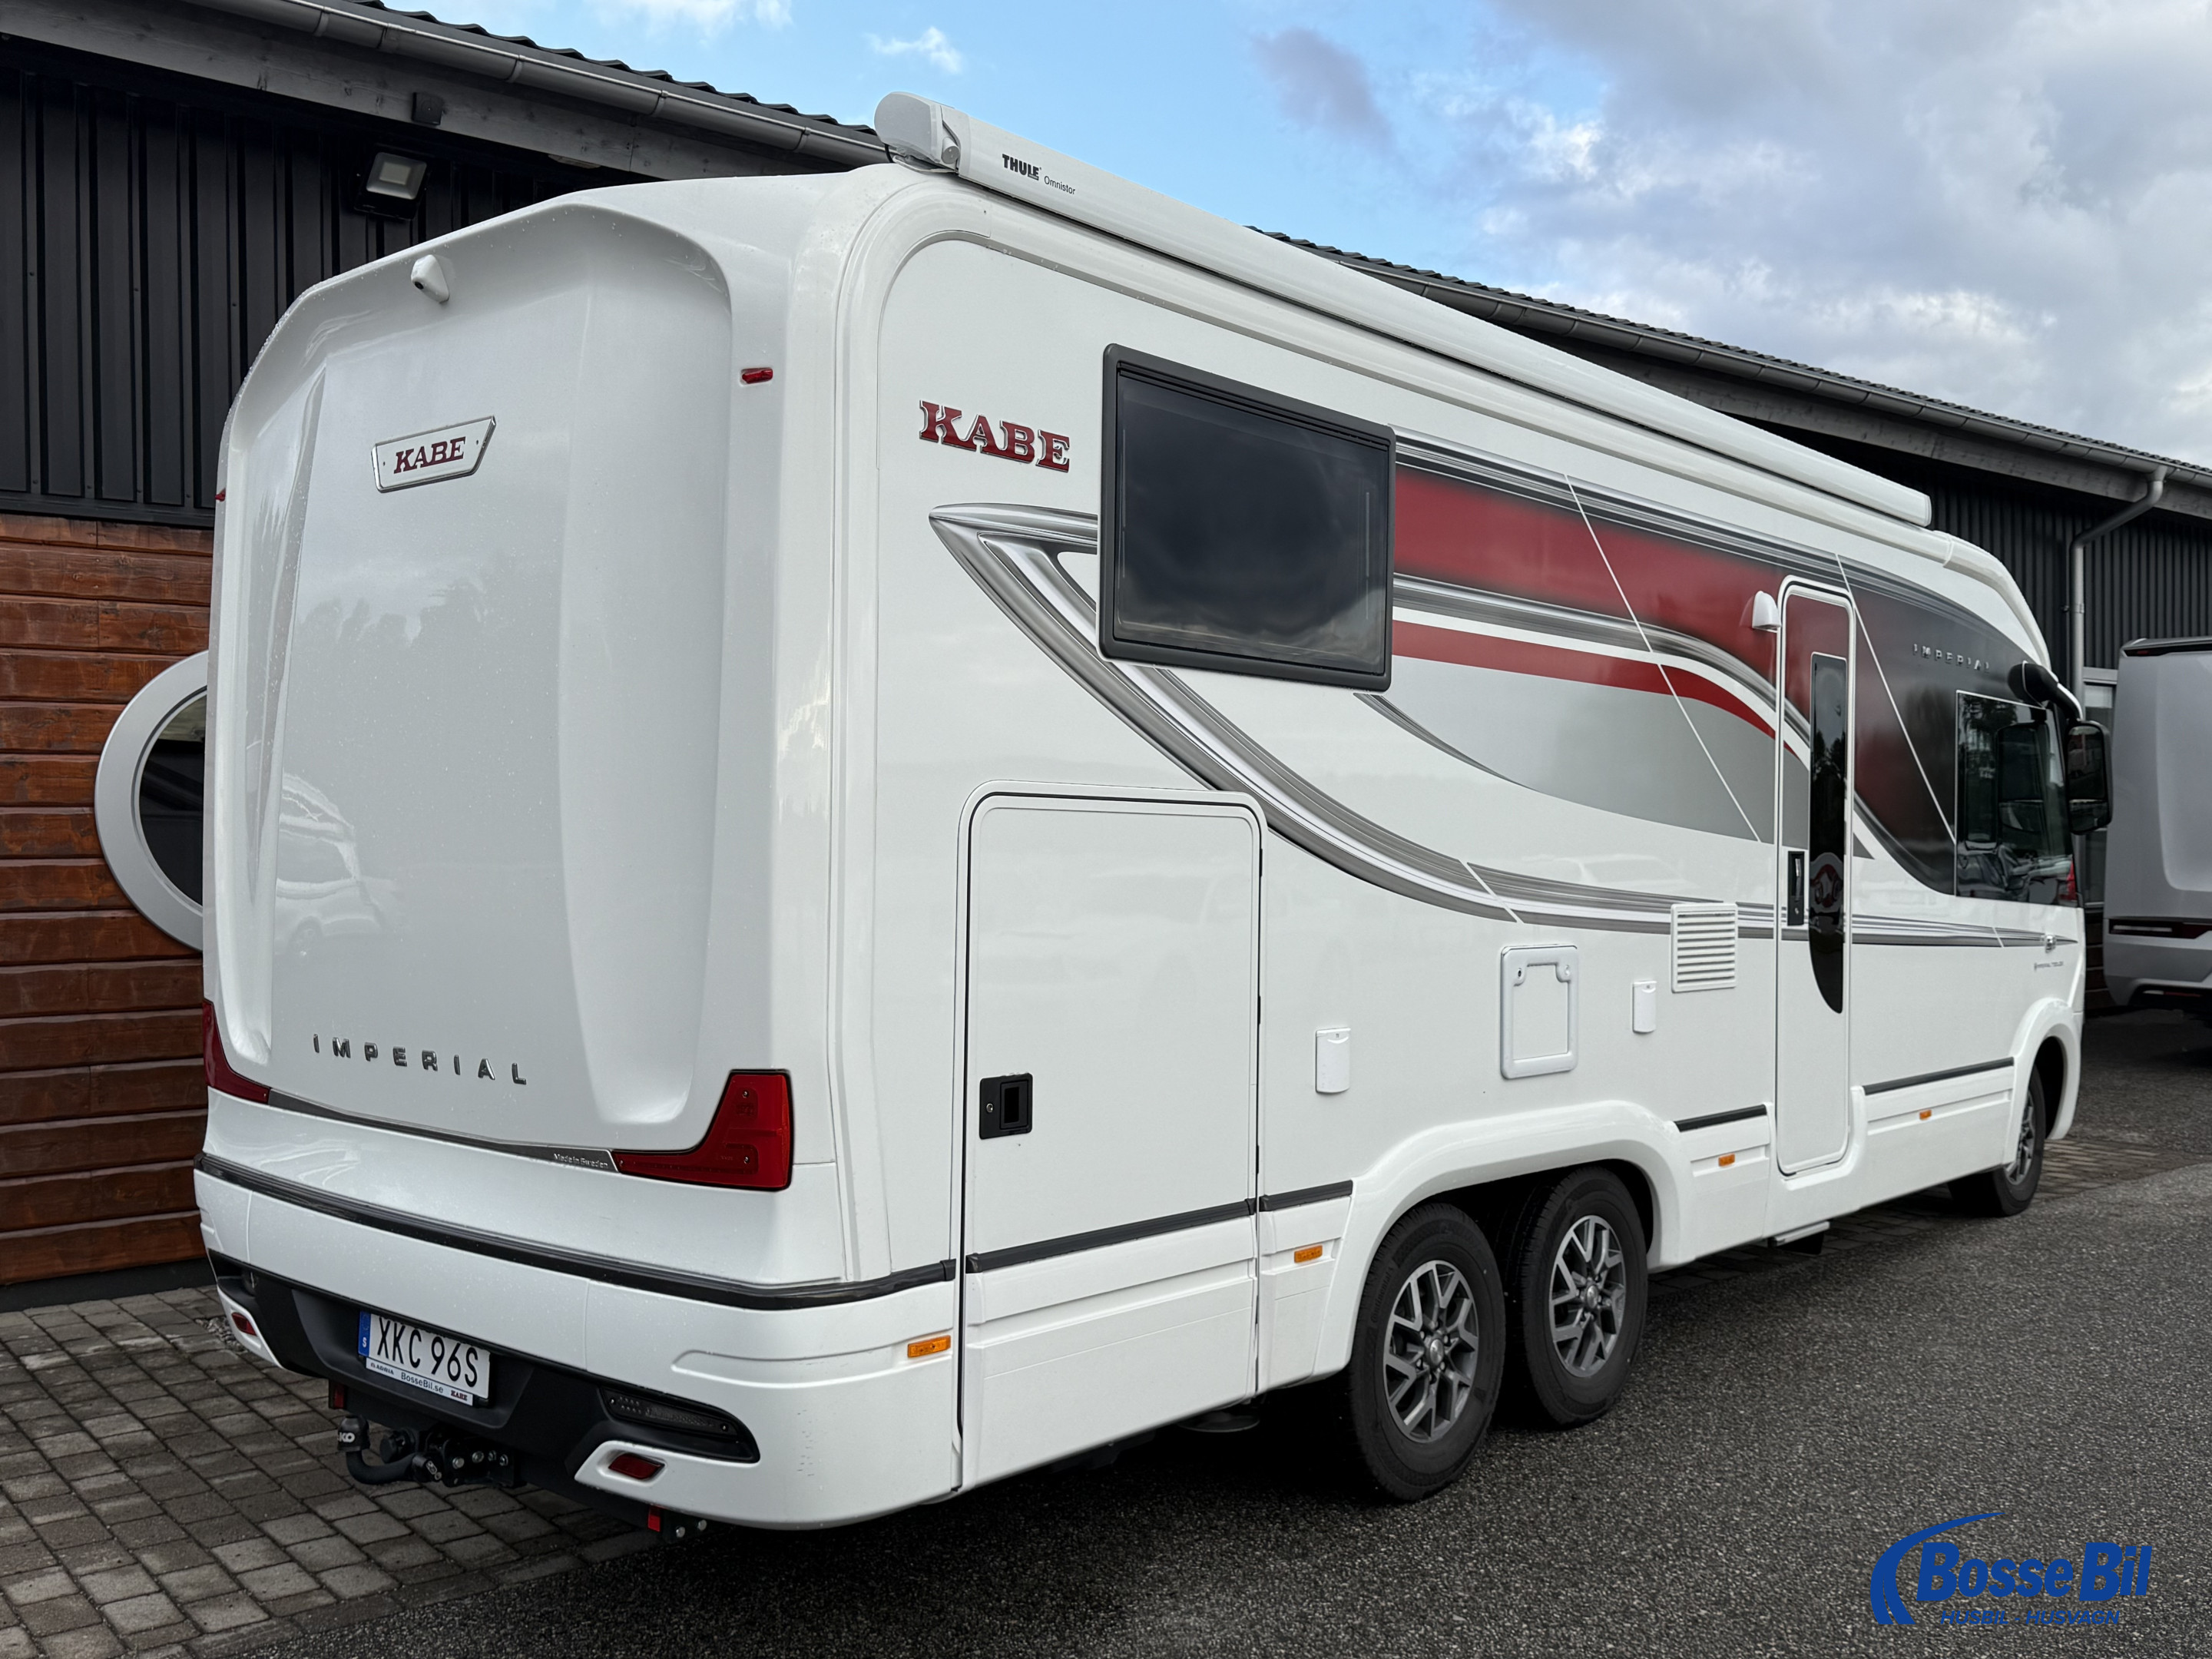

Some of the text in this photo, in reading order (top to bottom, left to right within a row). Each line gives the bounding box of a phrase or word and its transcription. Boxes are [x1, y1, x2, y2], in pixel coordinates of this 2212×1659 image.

[1002, 154, 1076, 194] THULE Omnistor
[393, 436, 466, 474] KABE
[919, 399, 1071, 473] KABE
[313, 1034, 527, 1085] IMPERIAL
[580, 1157, 609, 1168] Sweden
[376, 1316, 478, 1388] XKC 96S
[376, 1365, 395, 1375] ADRIA
[400, 1372, 444, 1393] BosseBil.se
